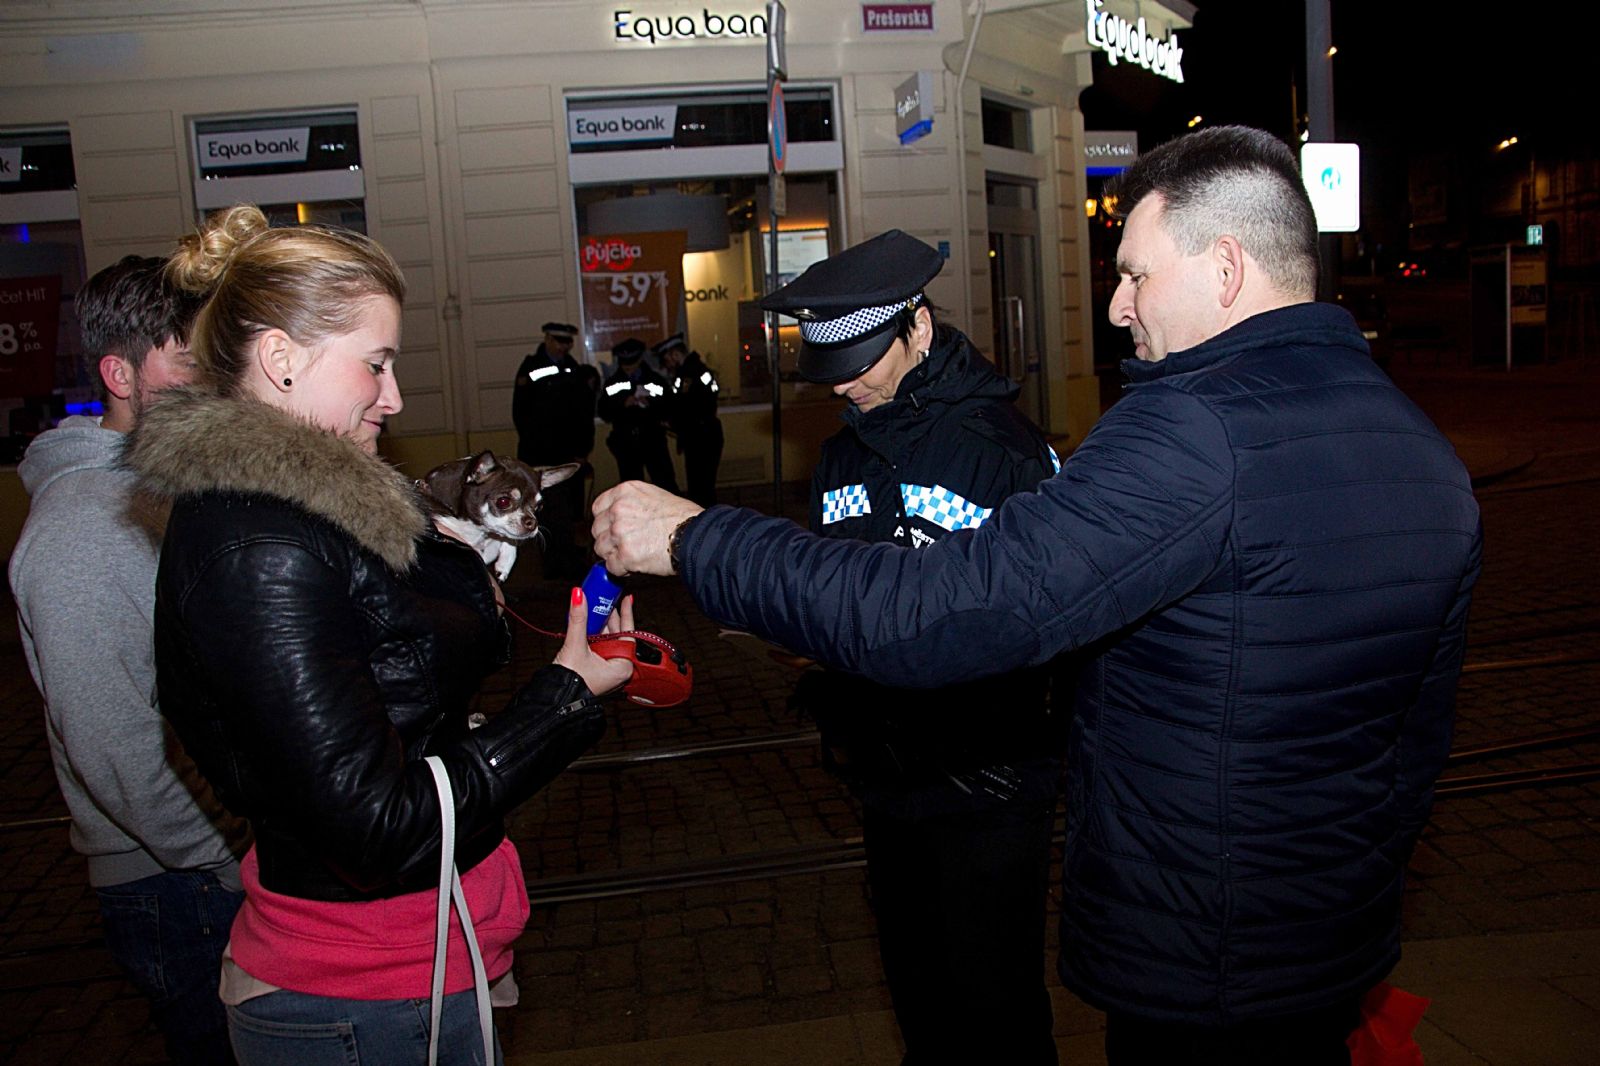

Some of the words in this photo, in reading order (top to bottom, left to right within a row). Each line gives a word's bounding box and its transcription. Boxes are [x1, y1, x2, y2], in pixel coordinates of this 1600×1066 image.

[615, 9, 695, 44] Equa
[703, 8, 767, 35] ban
[867, 9, 929, 27] Prešovská
[576, 118, 619, 137] Equa
[621, 115, 665, 132] bank
[208, 141, 252, 160] Equa
[255, 137, 300, 155] bank
[585, 242, 642, 264] Půjčka
[26, 287, 47, 302] HIT
